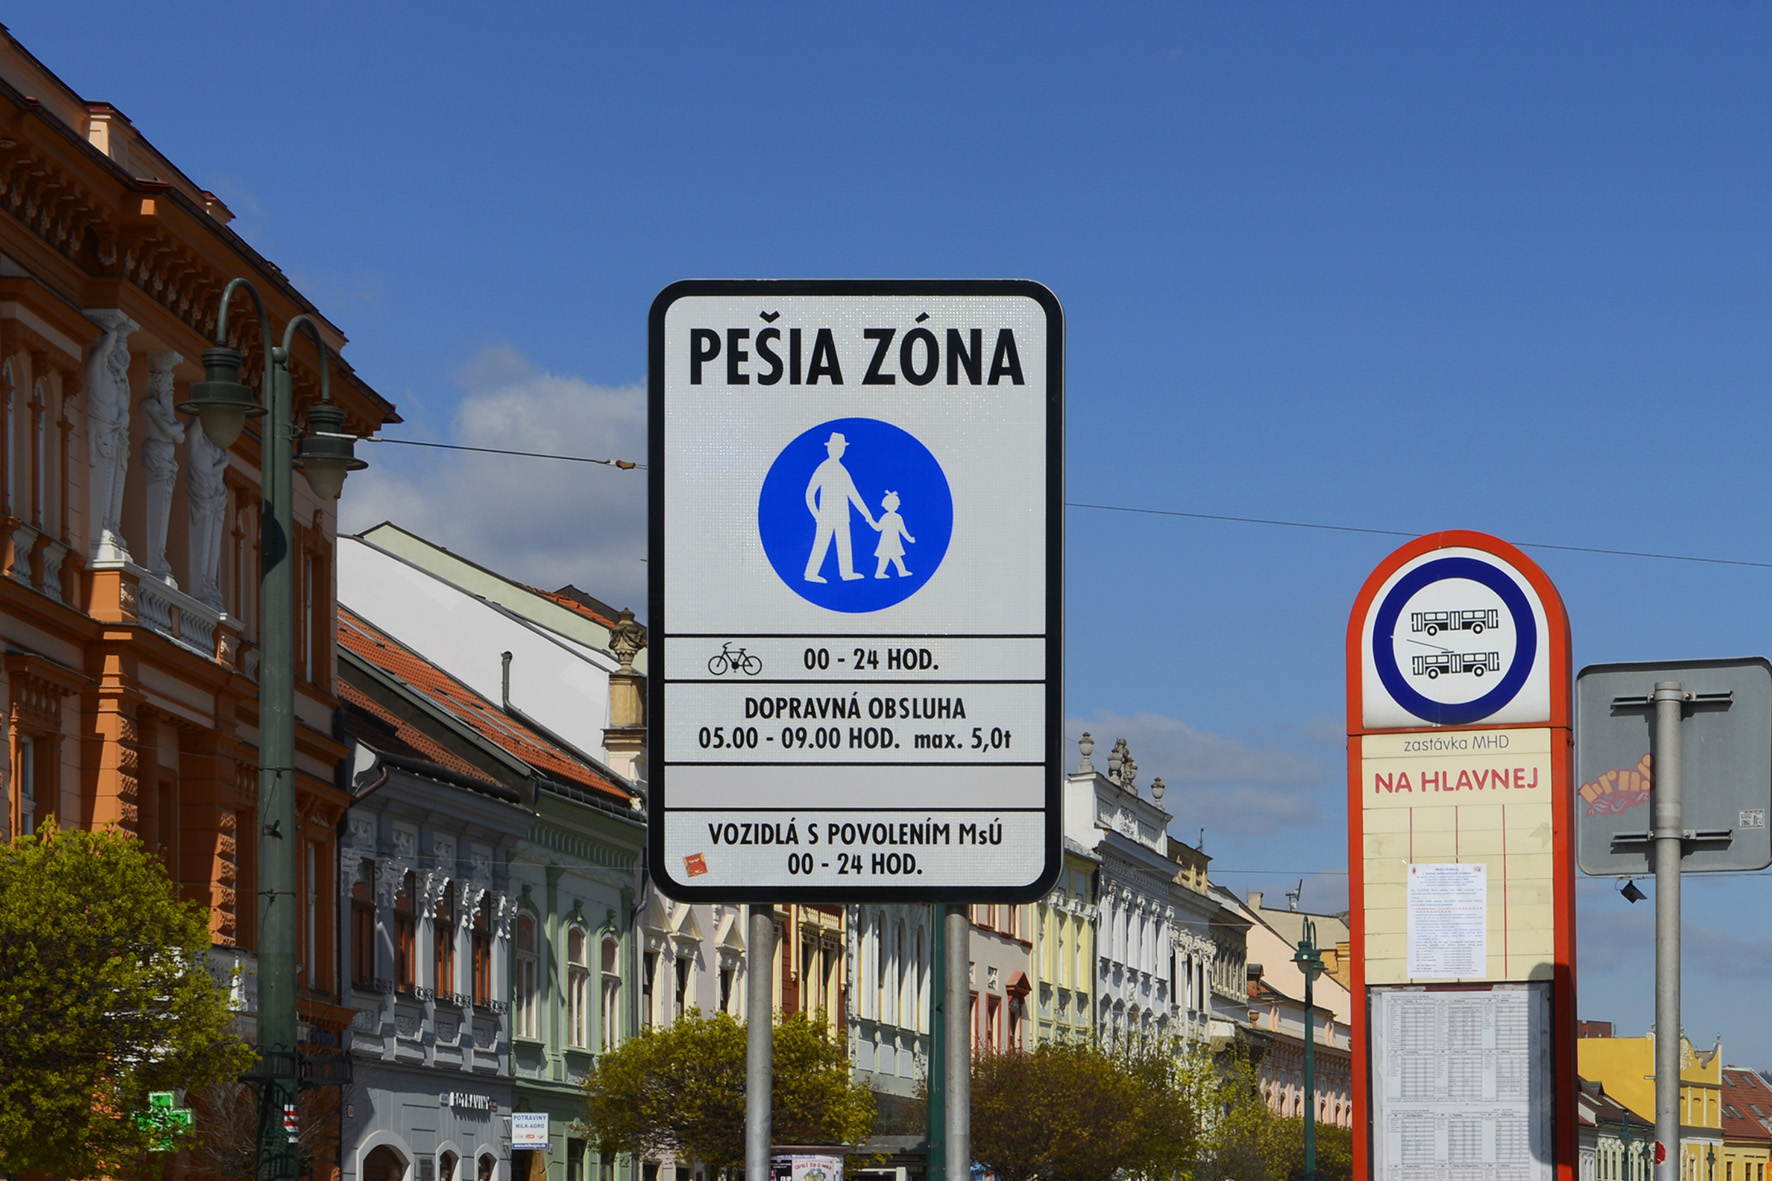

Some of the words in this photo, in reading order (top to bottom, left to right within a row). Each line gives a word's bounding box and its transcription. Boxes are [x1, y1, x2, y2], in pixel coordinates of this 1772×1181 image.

[691, 311, 843, 386] PEŠIA
[862, 312, 1025, 386] ZÓNA
[803, 647, 830, 671] 00
[853, 647, 880, 670] 24
[887, 647, 939, 671] HOD.
[745, 692, 861, 720] DOPRAVNÁ
[868, 697, 967, 720] OBSLUHA
[699, 726, 759, 749] 05.00
[781, 726, 841, 749] 09.00
[849, 726, 900, 749] HOD.
[914, 732, 963, 750] max.
[971, 726, 1012, 753] 5,0t
[1404, 736, 1468, 752] zastávka
[1472, 734, 1510, 750] MHD
[1375, 771, 1413, 794] NA
[1421, 767, 1539, 793] HLAVNEJ
[708, 817, 799, 845] VOZIDLÁ
[807, 823, 819, 845] S
[827, 817, 950, 846] POVOLENÍM
[958, 817, 1002, 846] MsÚ
[787, 852, 814, 875] 00
[837, 852, 864, 875] 24
[871, 852, 923, 875] HOD.
